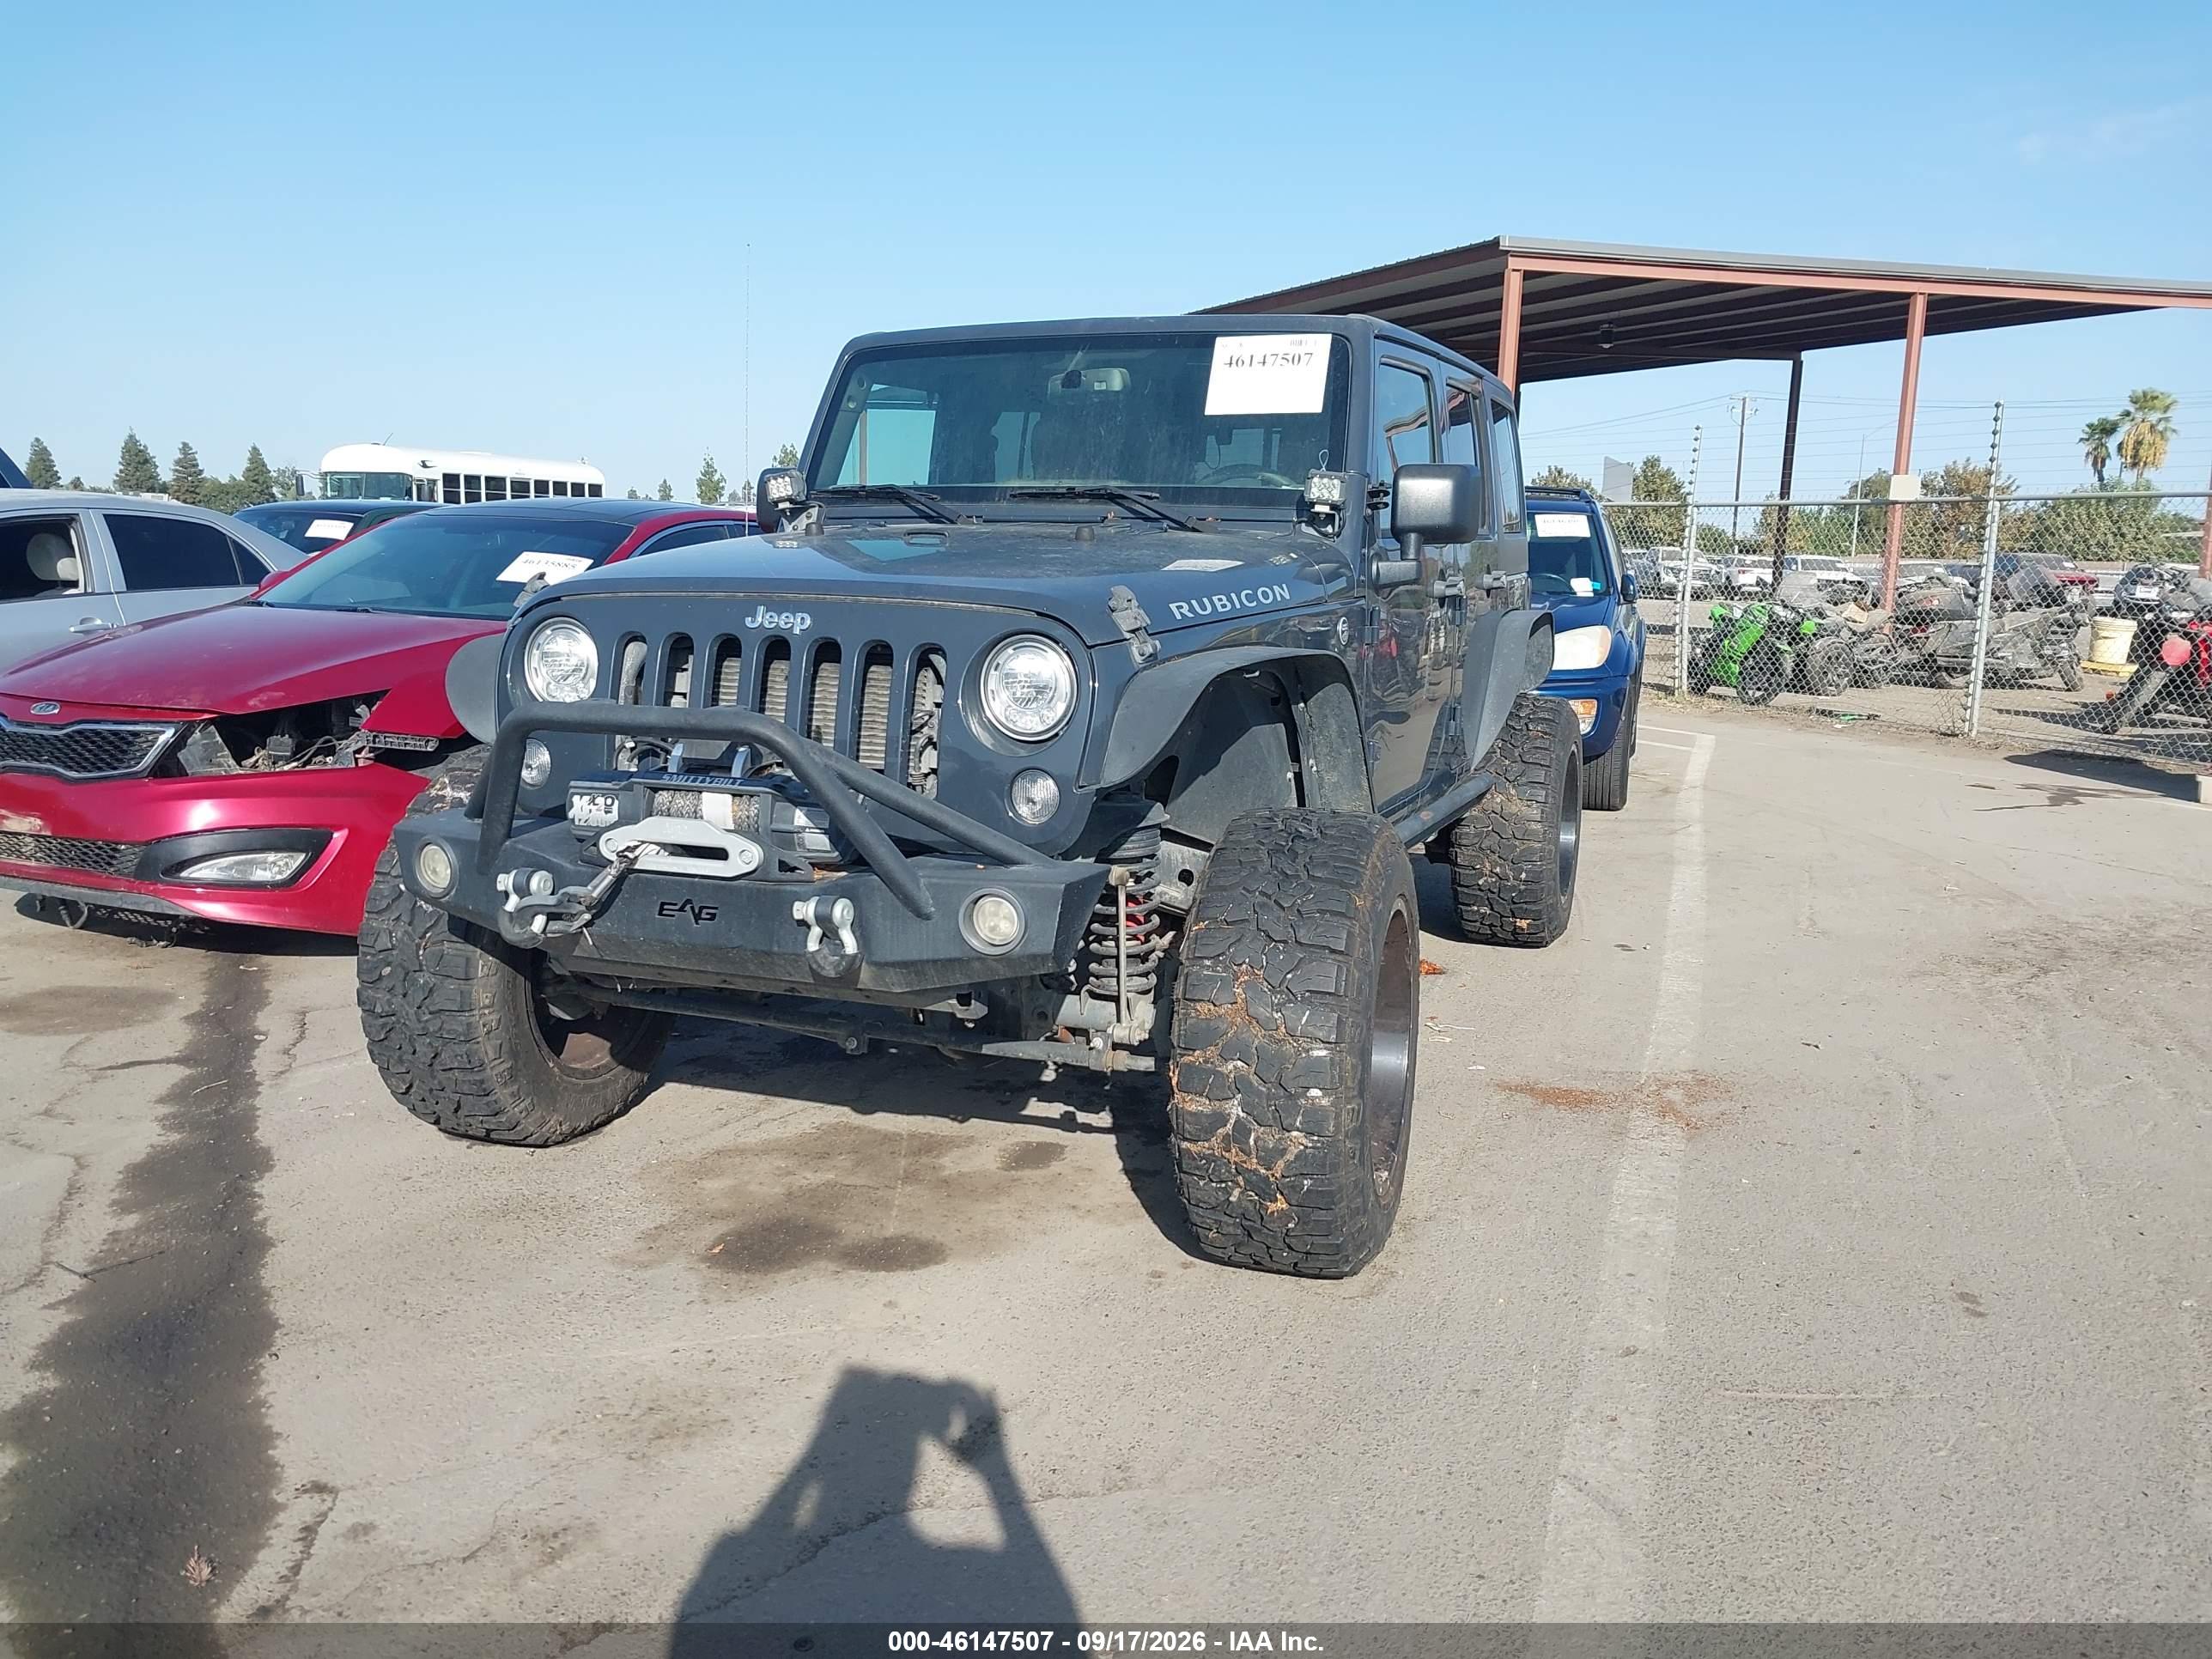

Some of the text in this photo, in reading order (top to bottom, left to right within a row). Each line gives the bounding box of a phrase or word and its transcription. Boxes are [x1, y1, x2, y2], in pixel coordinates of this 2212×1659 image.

[1224, 352, 1313, 368] 46147507
[1168, 583, 1291, 620] RUBICON
[744, 605, 811, 635] Jeep
[660, 774, 744, 787] SMITTYBILT
[658, 898, 719, 926] EAG
